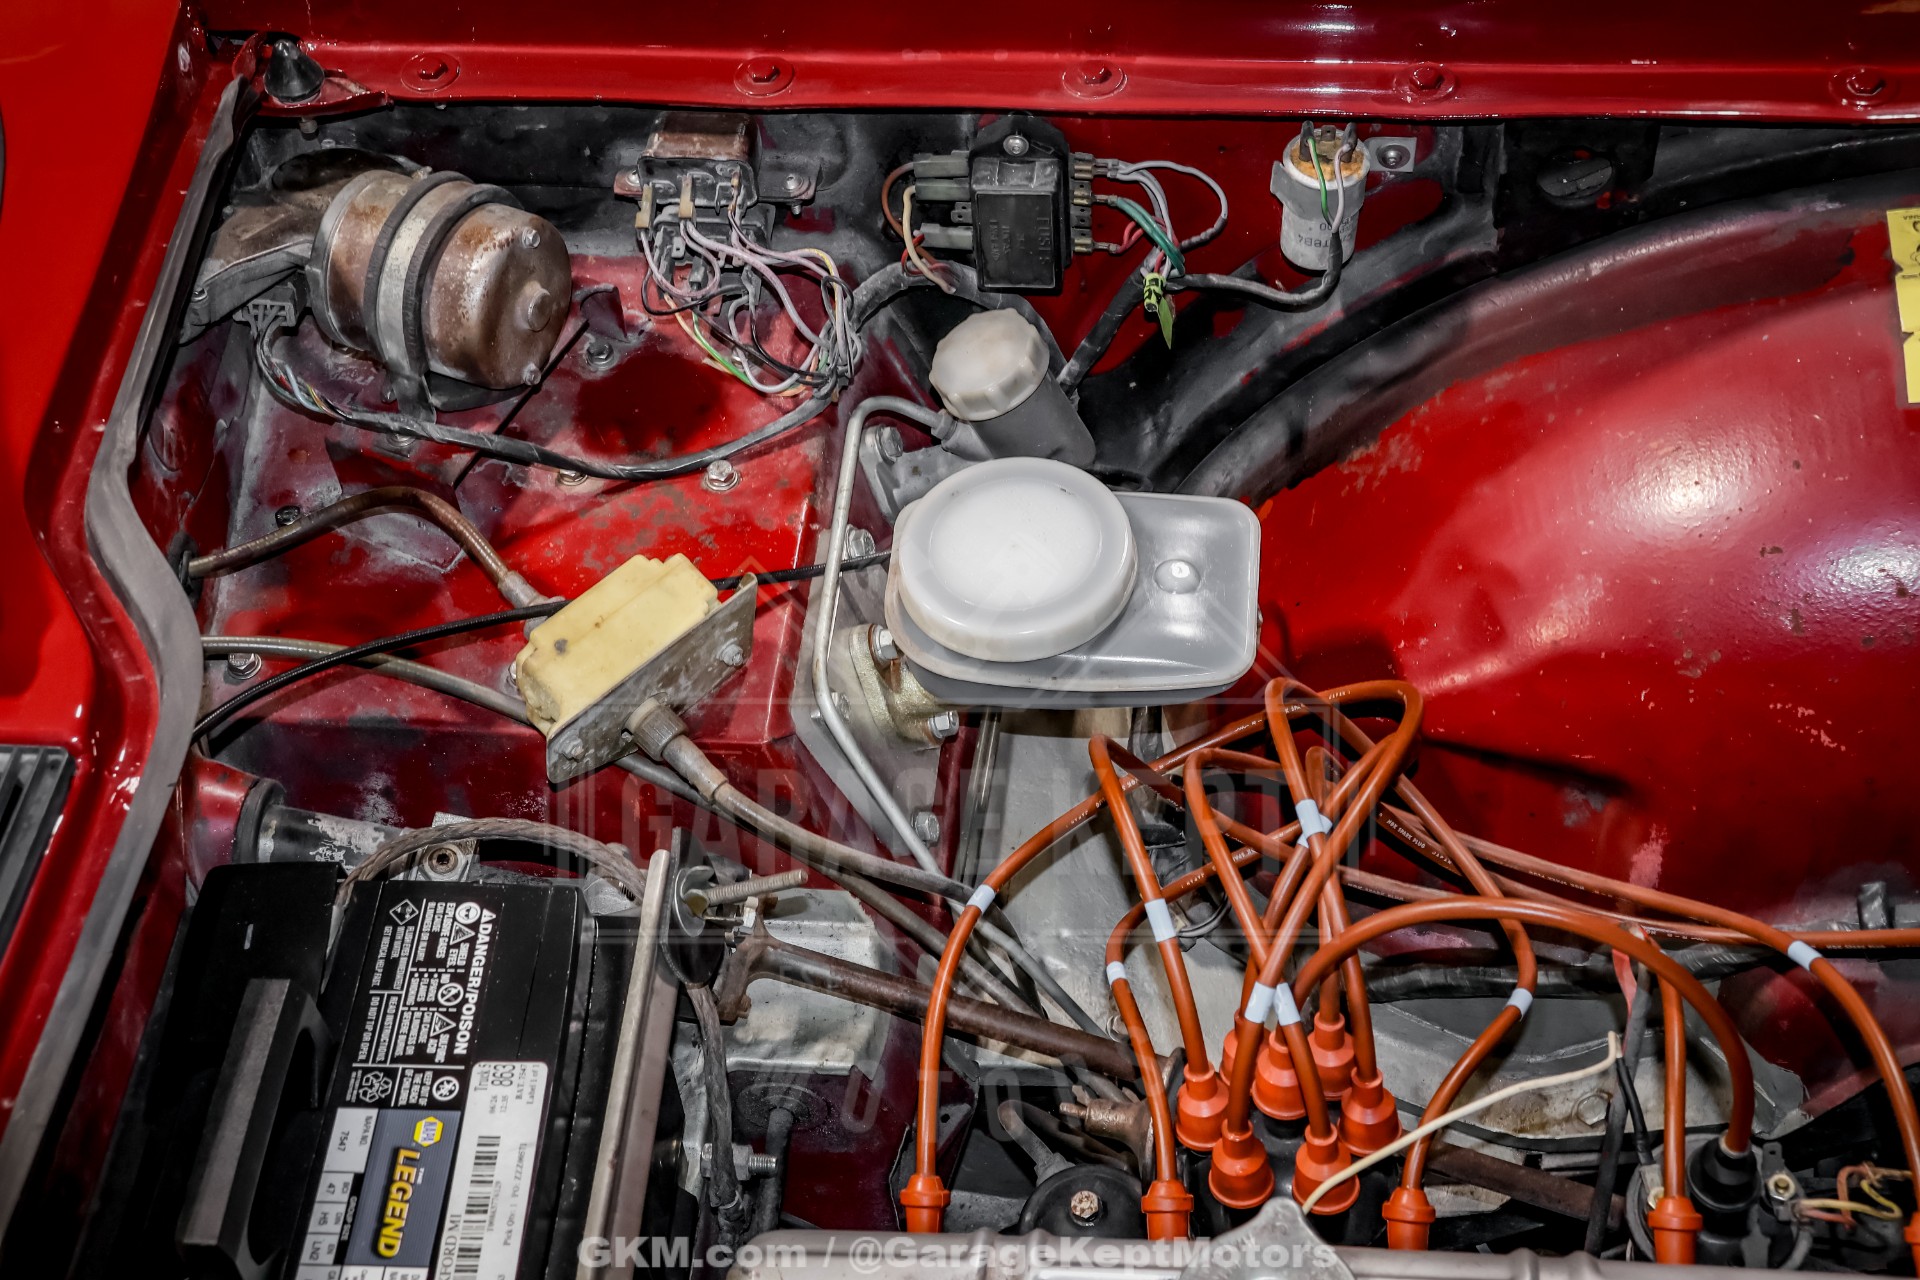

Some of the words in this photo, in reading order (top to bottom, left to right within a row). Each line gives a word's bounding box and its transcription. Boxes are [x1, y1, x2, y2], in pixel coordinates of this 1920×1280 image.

[1396, 826, 1413, 840] SPARK
[1411, 837, 1426, 849] PLUG
[424, 902, 436, 932] BLINDNESS
[433, 914, 441, 932] CAUSE
[440, 902, 456, 936] EXPLOSIVE
[378, 936, 390, 958] MEDICAL
[457, 943, 469, 965] SHIELD
[376, 958, 385, 972] HELP
[406, 977, 419, 1005] SMOKING
[417, 978, 428, 1002] FLAMES
[427, 978, 438, 1002] SPARKS
[454, 921, 492, 1054] DANGER/POISON
[370, 996, 380, 1006] DO
[387, 996, 398, 1014] READ
[368, 1007, 377, 1020] NOT
[400, 1010, 412, 1034] SEVERE
[365, 1021, 374, 1030] TIP
[408, 1010, 422, 1045] BLINDNESS
[418, 1024, 429, 1043] CAUSE
[362, 1032, 372, 1041] OR
[427, 1038, 437, 1053] ACID
[474, 1070, 490, 1091] Truck
[491, 1062, 516, 1086] 863
[526, 1085, 536, 1104] Label
[362, 1116, 372, 1134] NAPA
[422, 1121, 438, 1142] NAPA
[338, 1131, 349, 1151] 7547
[326, 1183, 335, 1194] 47
[347, 1195, 357, 1223] GROUP
[377, 1148, 420, 1258] LEGEND
[448, 1214, 461, 1231] MI
[309, 1241, 321, 1260] LN2
